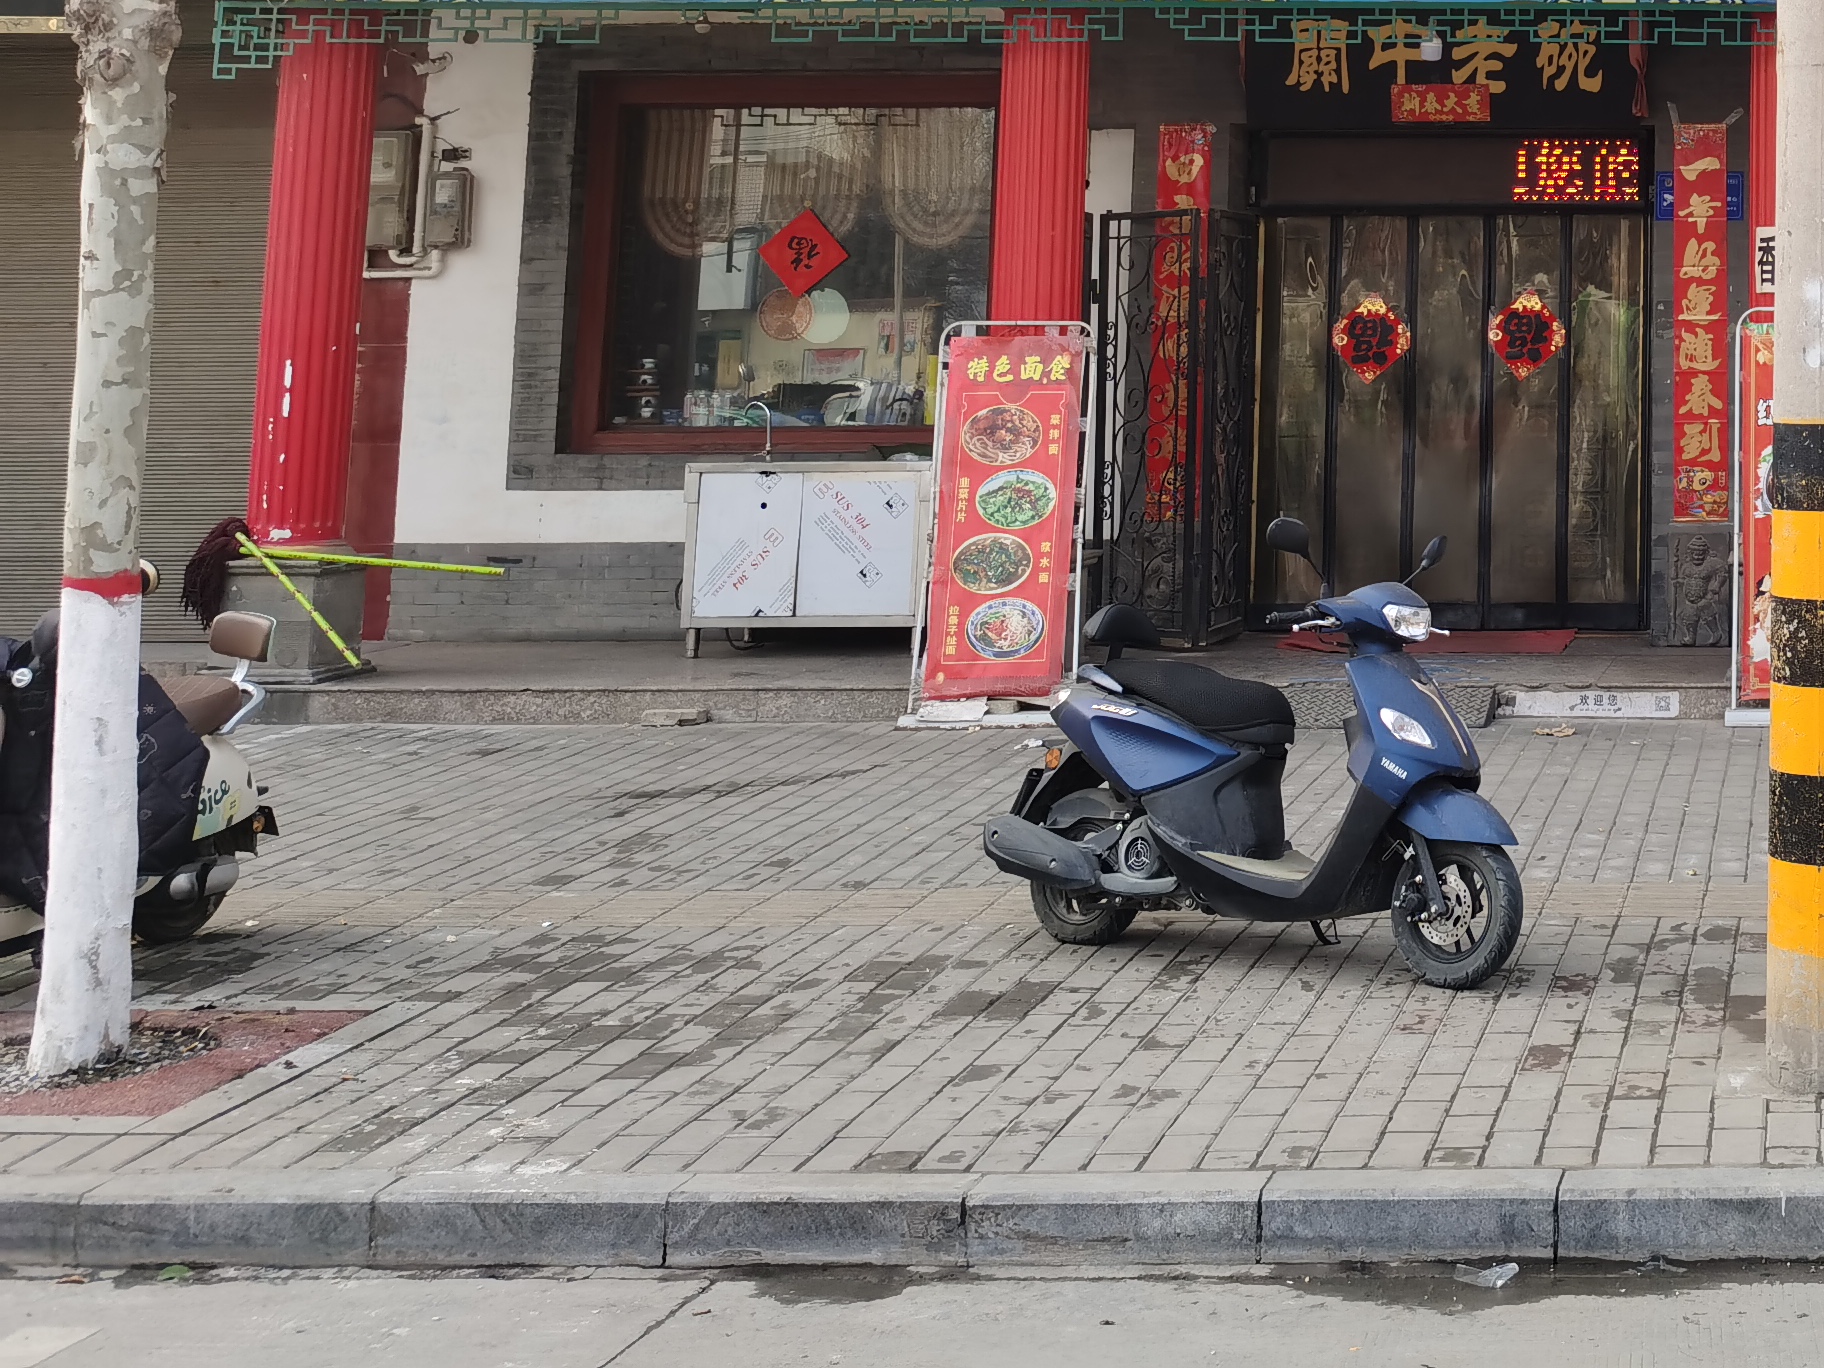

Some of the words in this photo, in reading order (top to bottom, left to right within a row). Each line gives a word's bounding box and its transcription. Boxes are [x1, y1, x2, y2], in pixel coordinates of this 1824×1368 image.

[1400, 91, 1482, 117] 新春大吉
[966, 355, 1071, 383] 特色面食
[830, 490, 854, 512] SUS
[850, 512, 872, 530] 304
[1579, 693, 1618, 707] 欢迎您
[1380, 756, 1408, 780] YAMAHA
